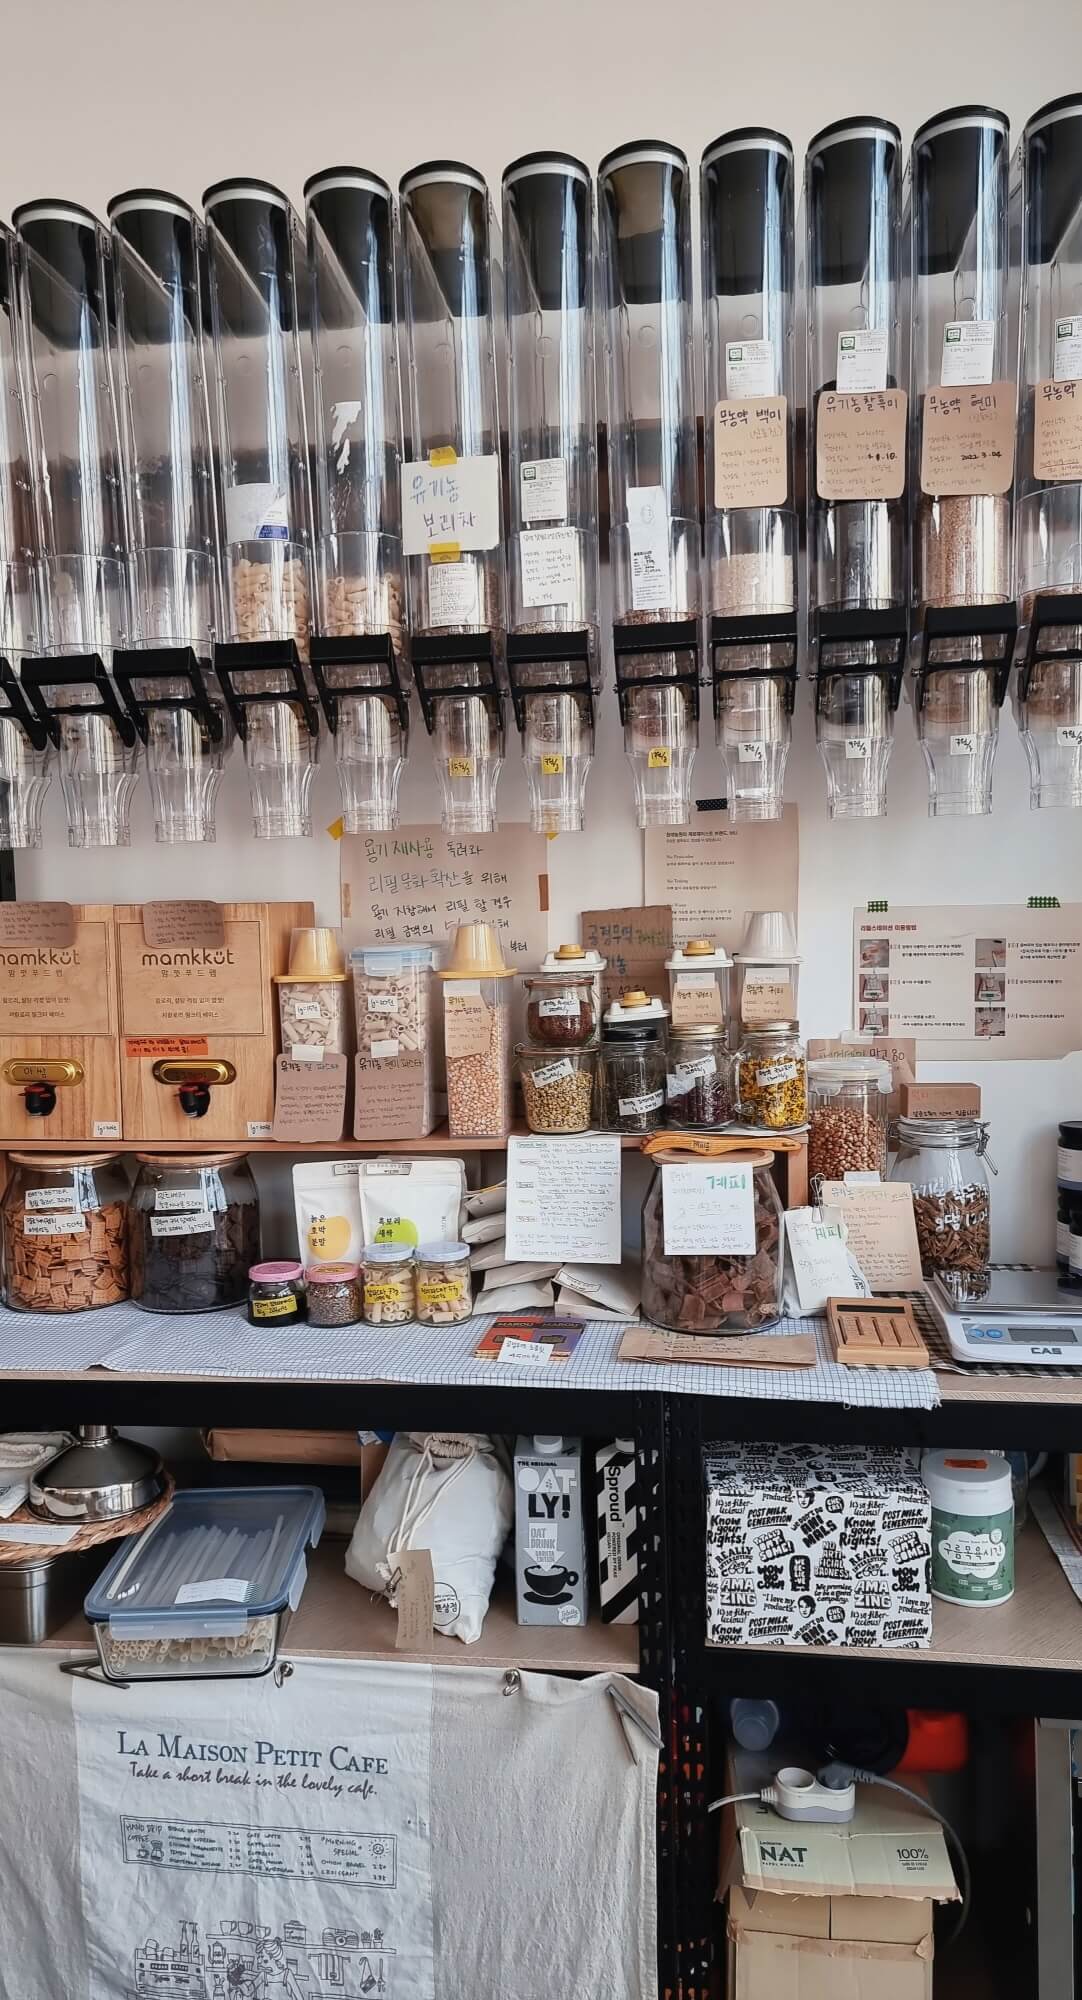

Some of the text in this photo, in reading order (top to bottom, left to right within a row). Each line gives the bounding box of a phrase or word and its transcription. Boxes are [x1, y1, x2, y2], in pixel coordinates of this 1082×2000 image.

[1043, 384, 1078, 401] 무농약
[930, 394, 997, 415] 무농약 현미
[720, 408, 782, 427] 무농약 백미
[411, 475, 459, 504] 유기농
[423, 511, 477, 537] 보리차
[365, 838, 388, 863] 용기
[480, 871, 508, 885] 위해
[370, 896, 513, 921] 용기 리필 할 경우
[373, 922, 435, 940] 리필 금액의
[510, 940, 529, 953] 부터
[281, 1060, 301, 1073] 유기농
[359, 1058, 382, 1074] 유기농
[705, 1174, 747, 1191] 계피
[379, 1217, 401, 1225] 흑보리
[310, 1226, 326, 1235] 호박
[312, 1238, 326, 1247] 분말
[1030, 1348, 1062, 1356] CAS
[606, 1466, 621, 1522] Sproud
[528, 1493, 571, 1518] LY!
[748, 1507, 788, 1519] POST MILK
[882, 1509, 924, 1521] POST MILK
[711, 1515, 742, 1527] Know
[747, 1515, 793, 1528] GENERATION
[844, 1516, 876, 1529] Know
[882, 1517, 928, 1530] GENERATION
[530, 1528, 546, 1538] OAT
[717, 1526, 742, 1534] your
[851, 1527, 876, 1536] your
[530, 1539, 556, 1549] DRINK
[707, 1529, 748, 1548] Rights!
[839, 1531, 882, 1550] Rights!
[714, 1546, 753, 1564] REALLY
[849, 1549, 889, 1565] REALLY
[943, 1542, 1002, 1561] 구름목욕시간
[757, 1565, 784, 1575] WOW
[891, 1567, 919, 1577] WOW
[720, 1592, 757, 1607] ZING
[770, 1595, 796, 1606] love my
[854, 1595, 892, 1609] ZING
[904, 1597, 918, 1606] love
[748, 1616, 790, 1628] POST MILK
[883, 1619, 924, 1631] POST MILK
[711, 1624, 742, 1636] Know
[748, 1624, 794, 1637] GENERATION
[845, 1627, 877, 1639] Know
[882, 1627, 929, 1640] GENERATION
[717, 1634, 743, 1643] your
[851, 1636, 877, 1647] your
[117, 1731, 389, 1776] LA MAISON PETIT CAFE
[129, 1761, 378, 1800] Take a short break in the lovely cafe.
[760, 1845, 809, 1863] NAT
[896, 1847, 929, 1860] 100%
